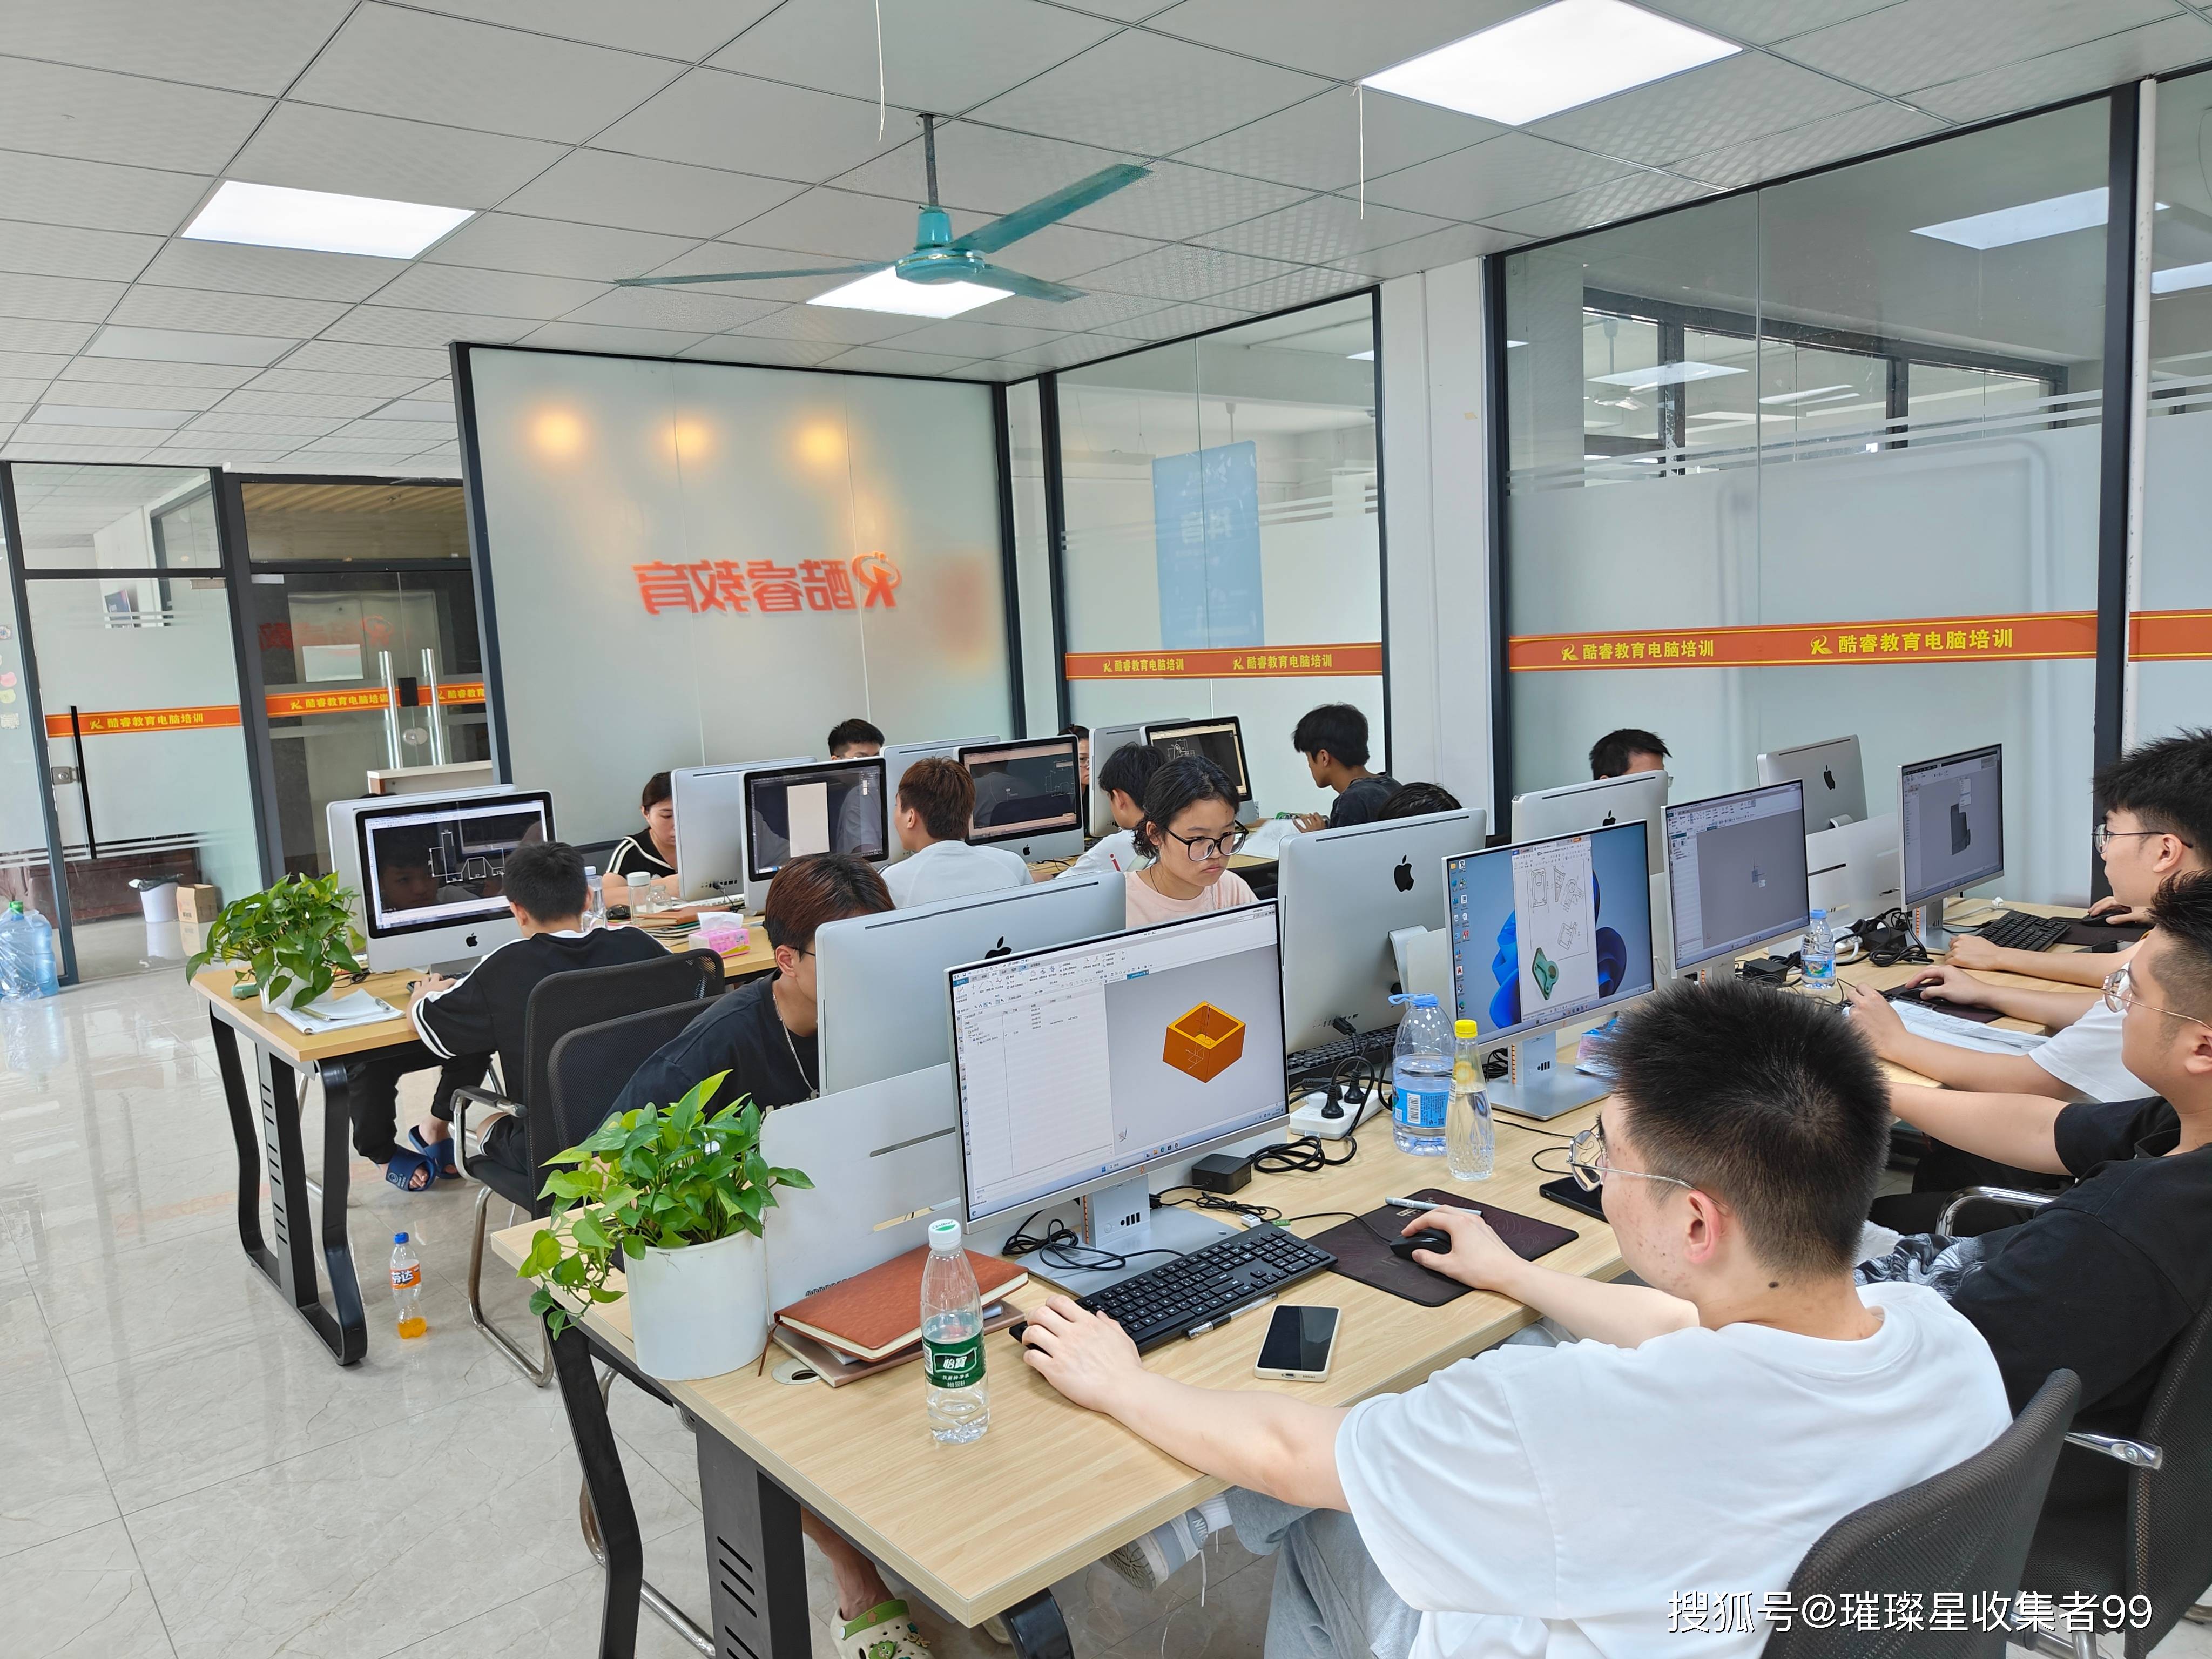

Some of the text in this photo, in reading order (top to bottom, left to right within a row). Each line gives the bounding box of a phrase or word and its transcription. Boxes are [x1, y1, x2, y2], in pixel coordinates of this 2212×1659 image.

[1838, 628, 2013, 653] 酷睿教育电脑培训
[1582, 640, 1714, 660] 酷睿教育电脑培训
[1114, 658, 1184, 672] 酷睿教育电脑培训
[1246, 654, 1332, 669] 酷睿教育电脑培训
[107, 713, 204, 728] 酷睿教育电脑培训
